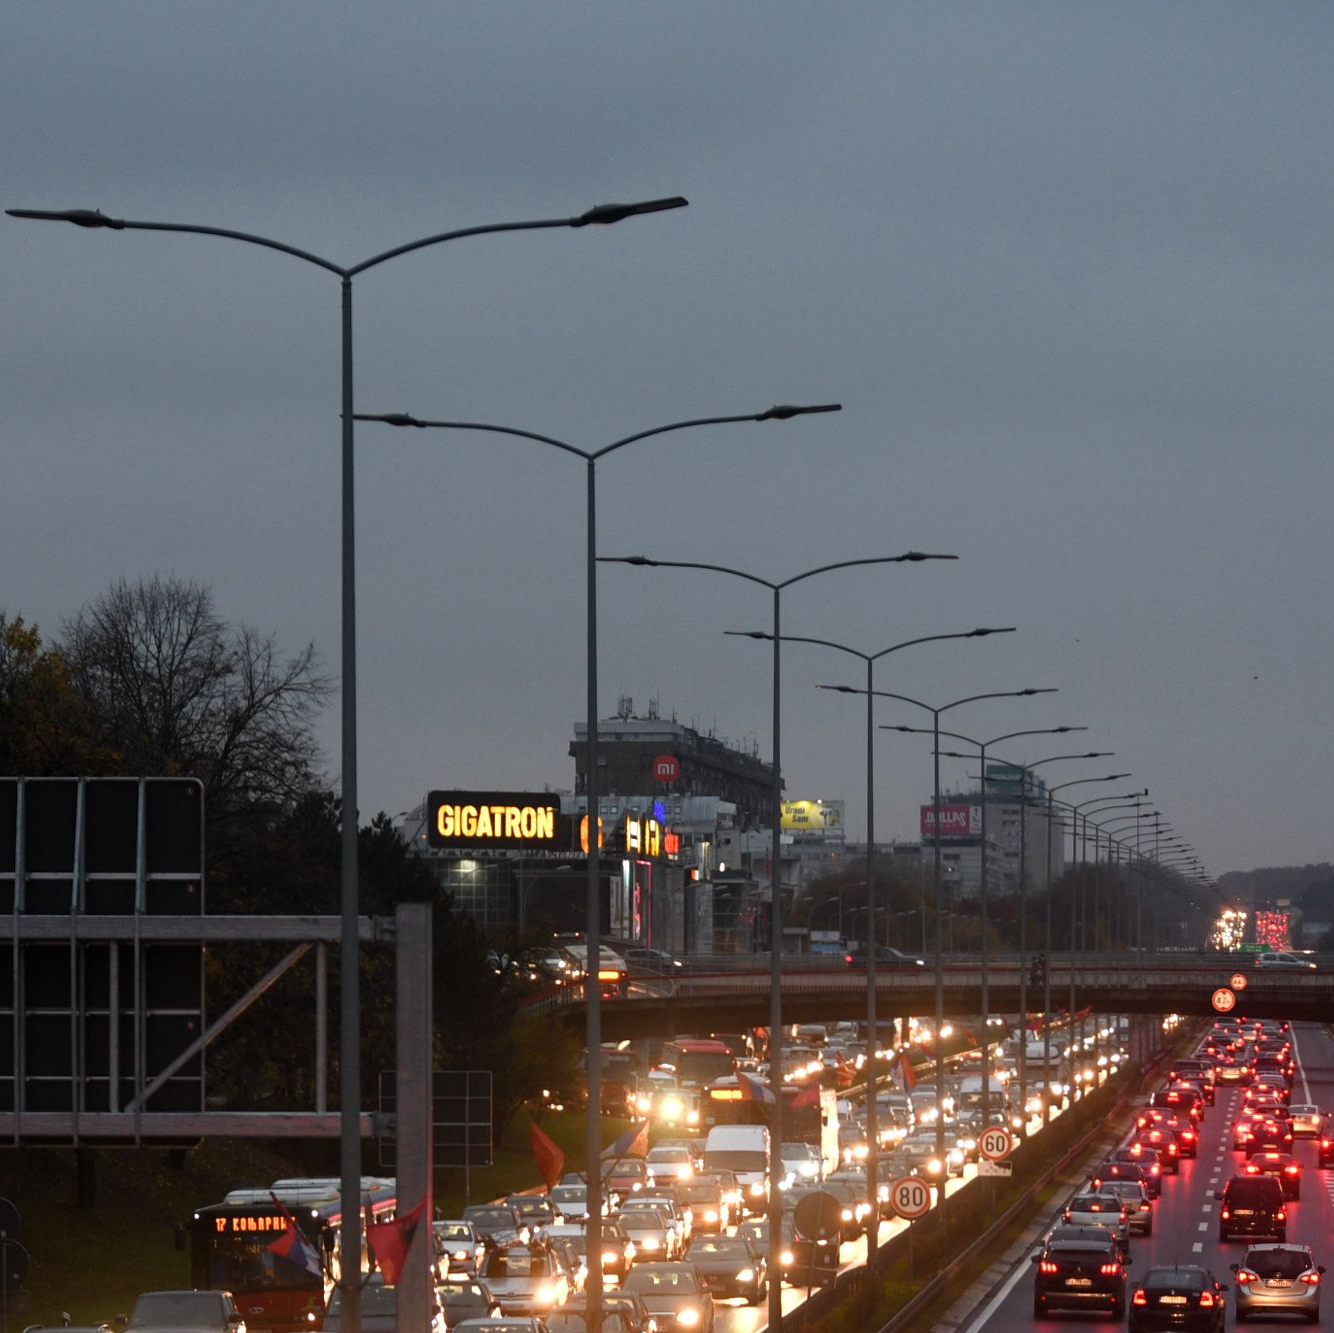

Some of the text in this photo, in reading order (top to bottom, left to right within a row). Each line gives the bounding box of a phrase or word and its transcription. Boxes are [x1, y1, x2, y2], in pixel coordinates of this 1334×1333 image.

[437, 803, 554, 839] GIGATRON
[985, 1141, 1005, 1153] 60
[899, 1187, 924, 1208] 80
